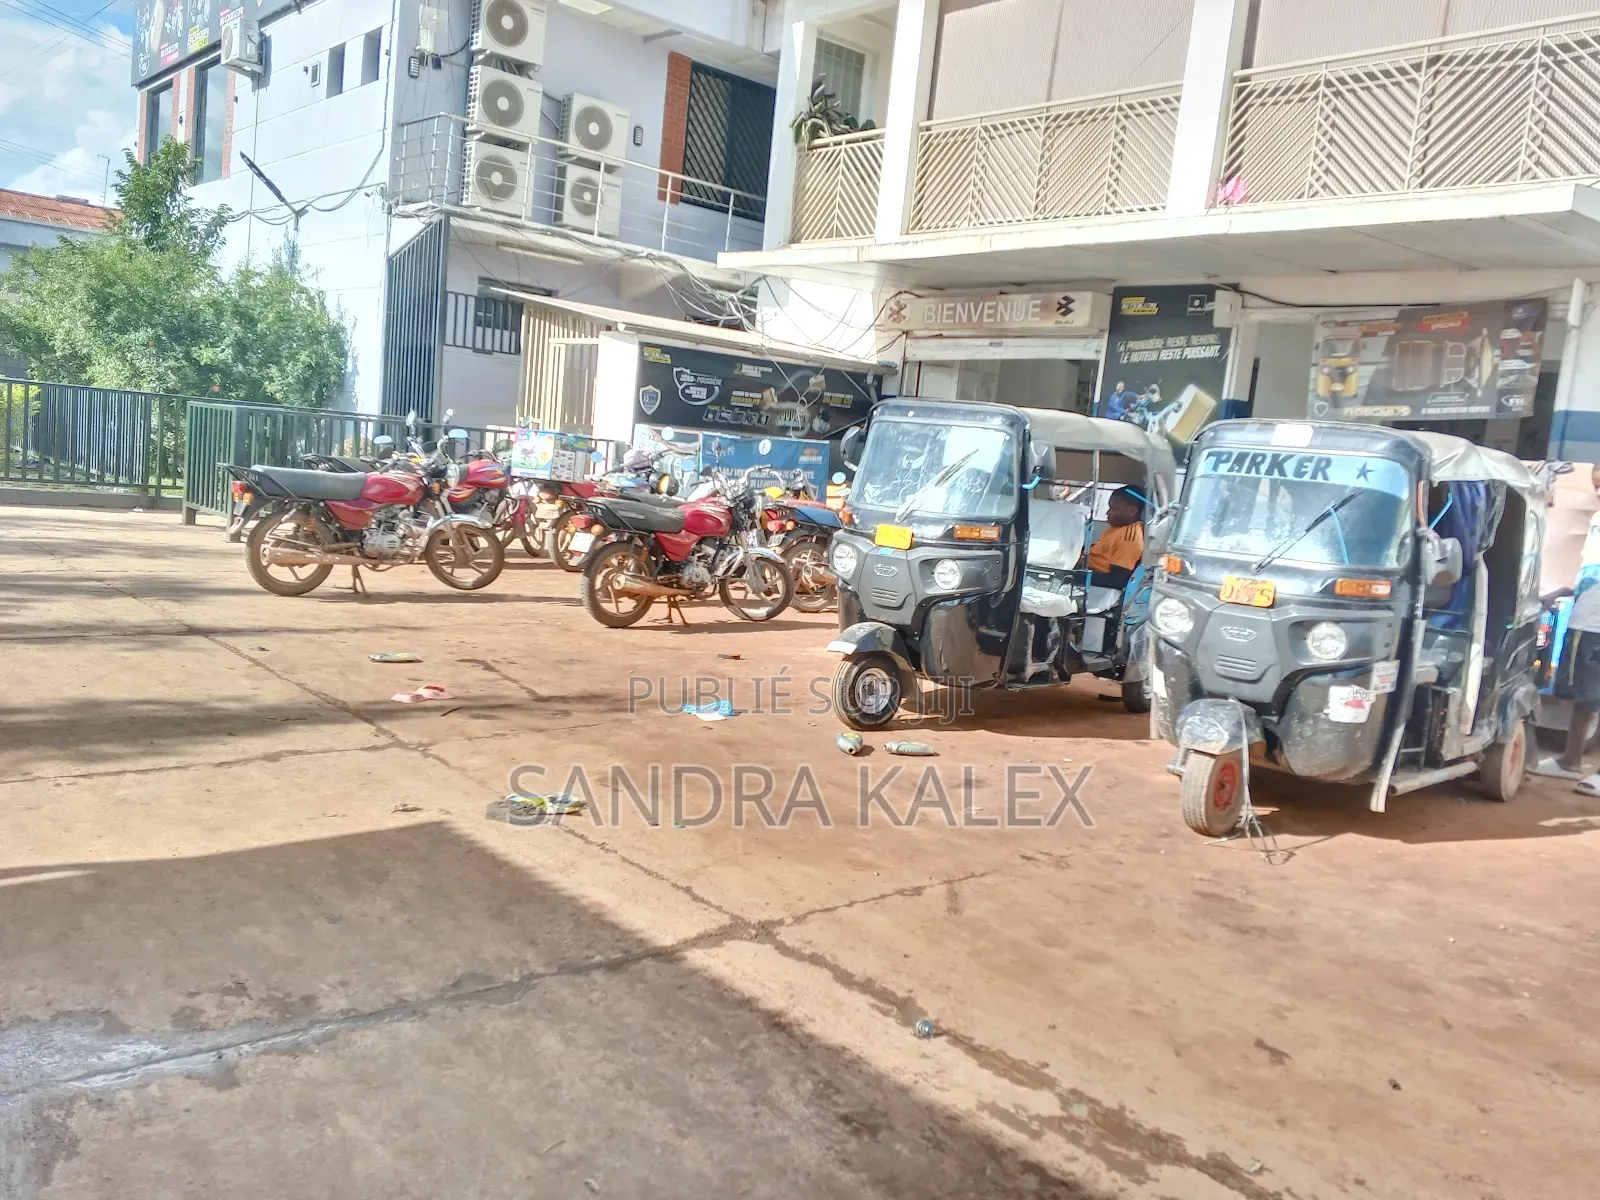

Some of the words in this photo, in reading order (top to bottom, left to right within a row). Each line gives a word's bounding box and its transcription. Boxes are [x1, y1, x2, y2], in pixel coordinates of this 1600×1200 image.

[923, 300, 1043, 325] BIENVENUE
[1119, 352, 1130, 364] LE
[1129, 350, 1160, 363] MOTEUR
[1159, 348, 1183, 361] RESTE
[1204, 451, 1335, 482] PARKER
